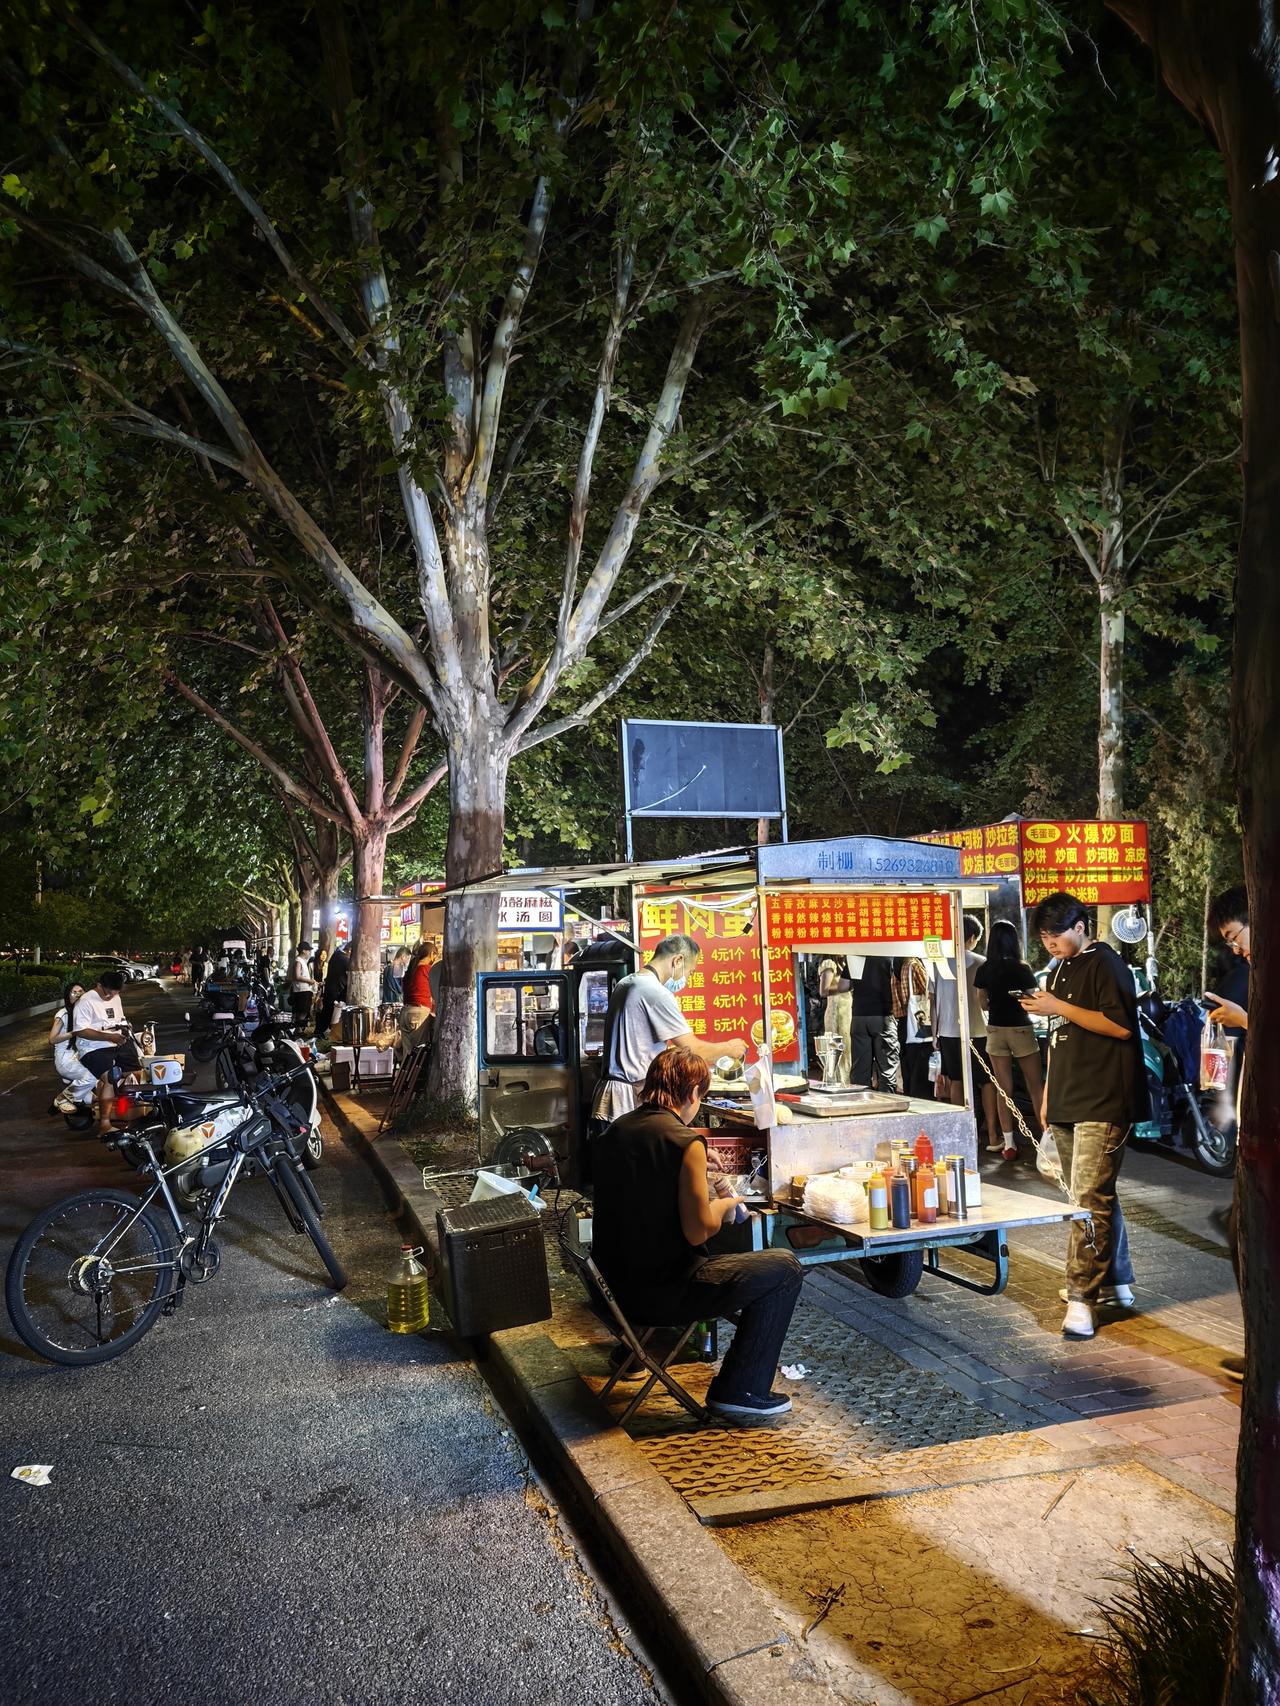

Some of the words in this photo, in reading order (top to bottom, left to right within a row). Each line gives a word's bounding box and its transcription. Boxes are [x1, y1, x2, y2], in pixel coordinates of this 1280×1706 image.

[1066, 823, 1134, 844] 火爆炒面
[963, 853, 995, 875] 炒凉皮
[1023, 847, 1047, 864] 炒饼
[1055, 847, 1078, 864] 炒面
[1086, 847, 1119, 864] 炒河粉
[1125, 847, 1147, 864] 凉皮
[1024, 867, 1059, 884] 炒拉条
[1064, 866, 1109, 883] 炒方便面
[1111, 866, 1144, 883] 蛋炒饭
[711, 946, 745, 961] 4元1个
[712, 969, 747, 985] 4元1个
[713, 992, 748, 1009] 4元1个
[714, 1016, 749, 1032] 5元1个
